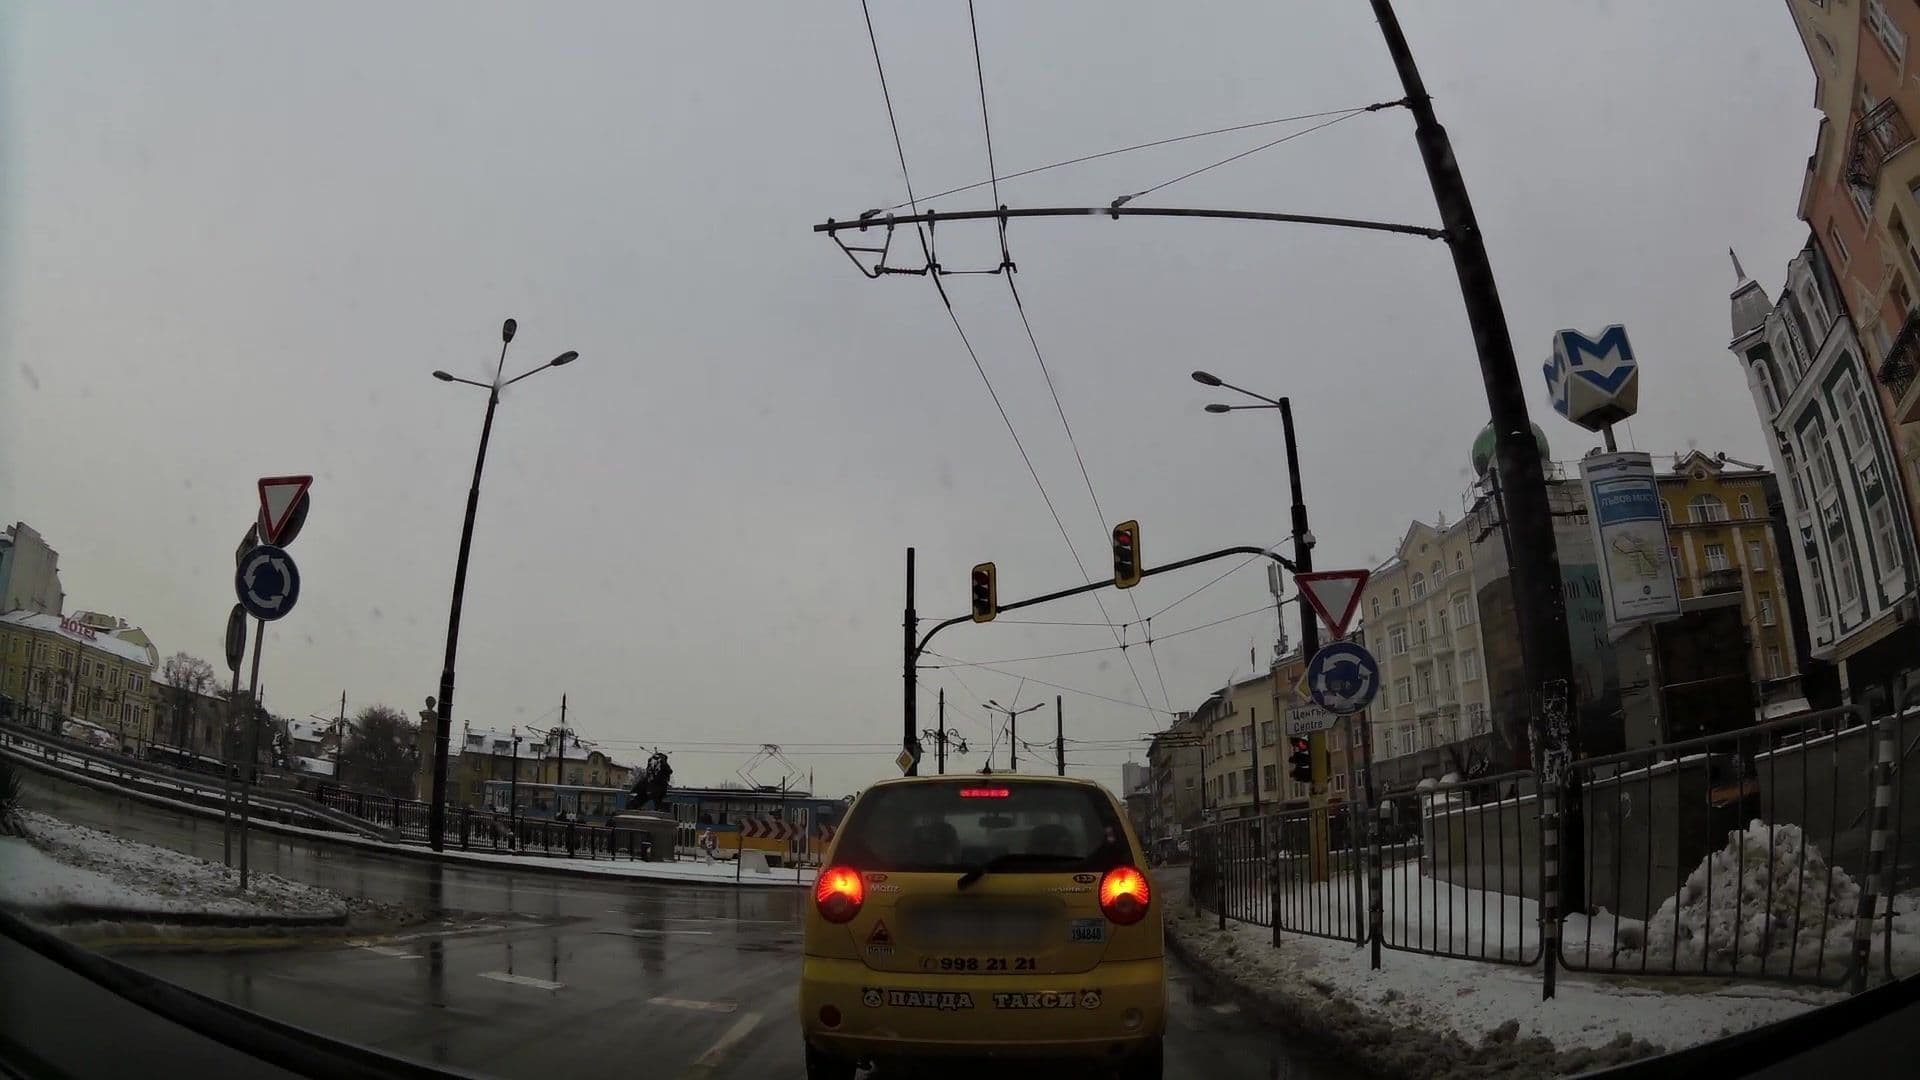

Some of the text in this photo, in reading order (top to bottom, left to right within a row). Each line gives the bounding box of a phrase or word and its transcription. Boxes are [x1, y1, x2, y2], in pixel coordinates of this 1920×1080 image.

[61, 617, 97, 640] HOTEL
[1293, 721, 1323, 732] Centre
[941, 958, 1036, 970] 998 21 21
[888, 990, 1076, 1010] ПАНДА ТАКСИ
